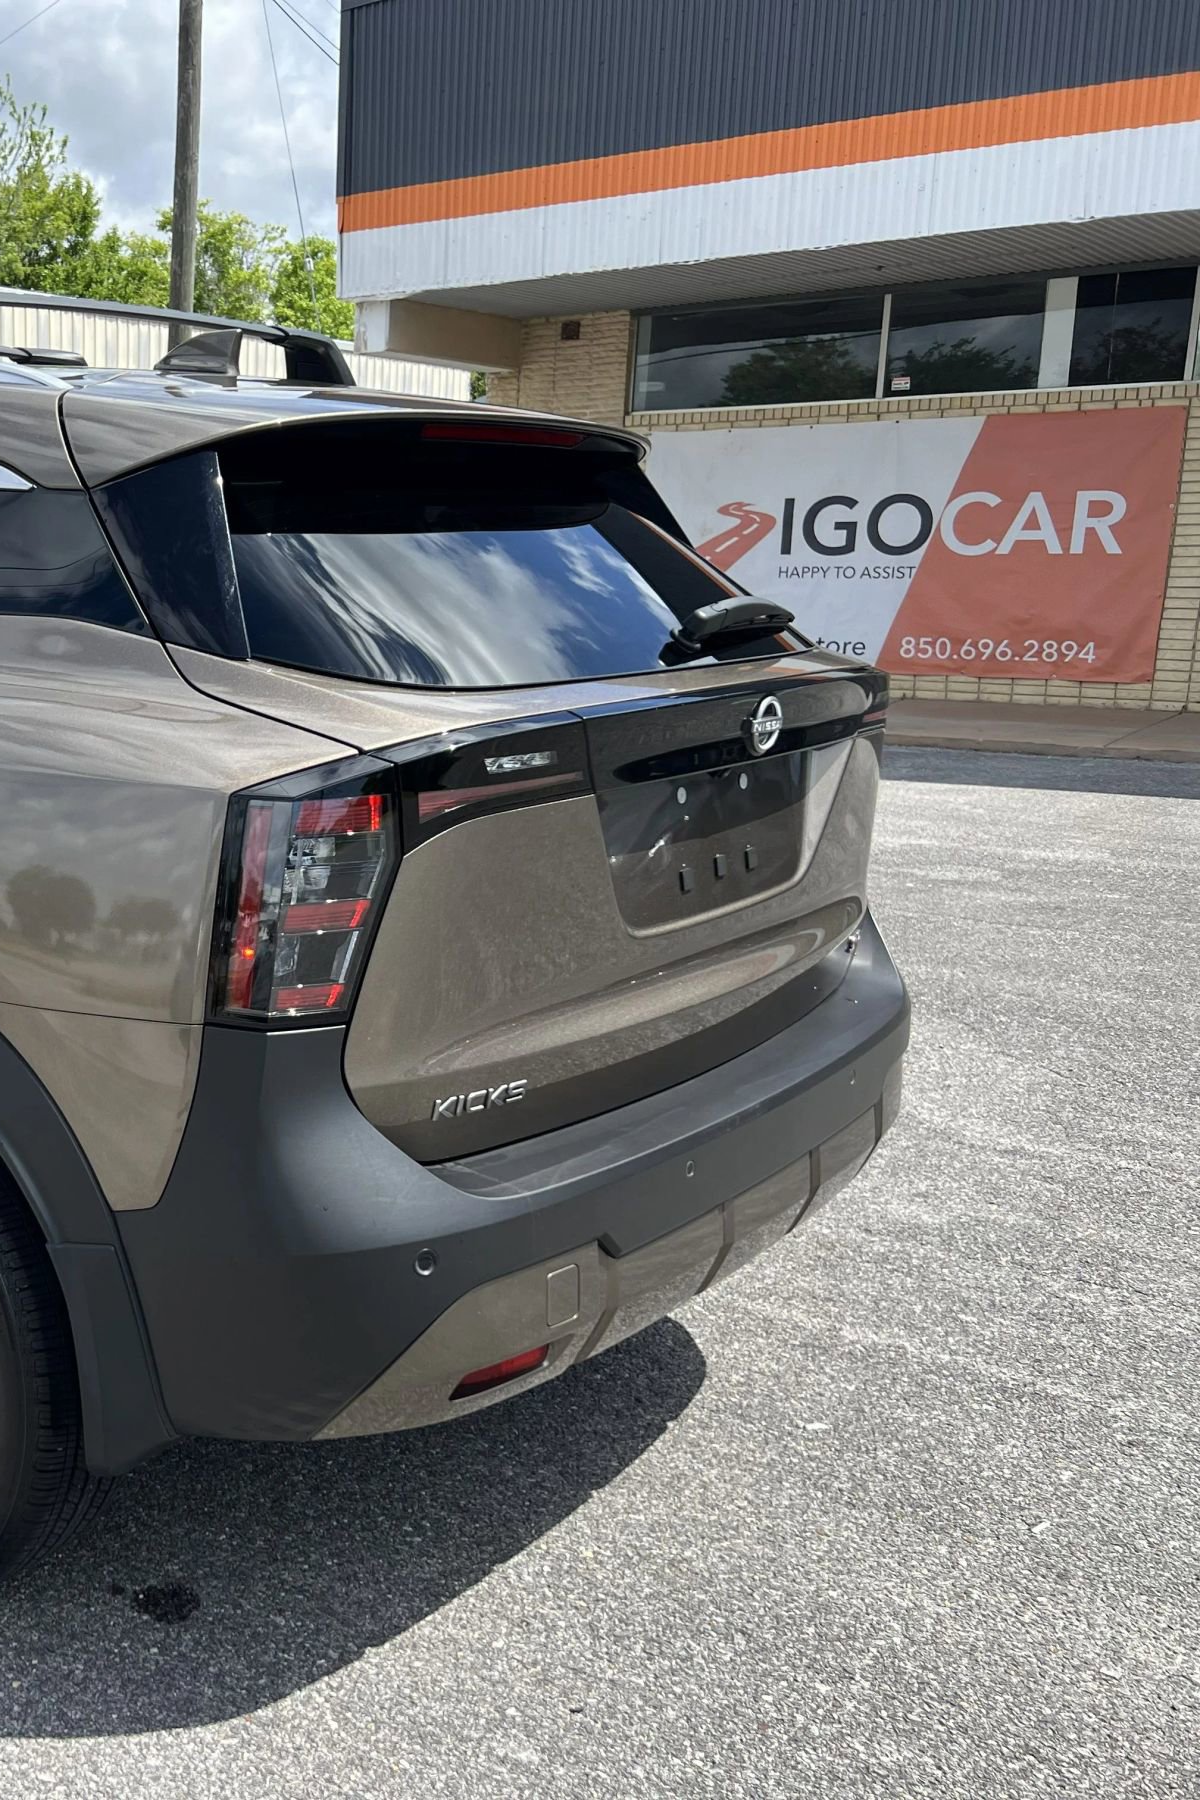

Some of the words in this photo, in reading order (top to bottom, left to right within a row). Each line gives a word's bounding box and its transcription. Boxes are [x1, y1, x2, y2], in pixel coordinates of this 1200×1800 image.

[779, 489, 1127, 557] IGOCAR
[777, 565, 831, 580] HAPPY
[833, 565, 856, 580] TO
[859, 565, 917, 580] ASSIST
[899, 636, 1097, 664] 850.696.2894
[752, 719, 782, 733] NISSA
[431, 1078, 528, 1122] KICKS
